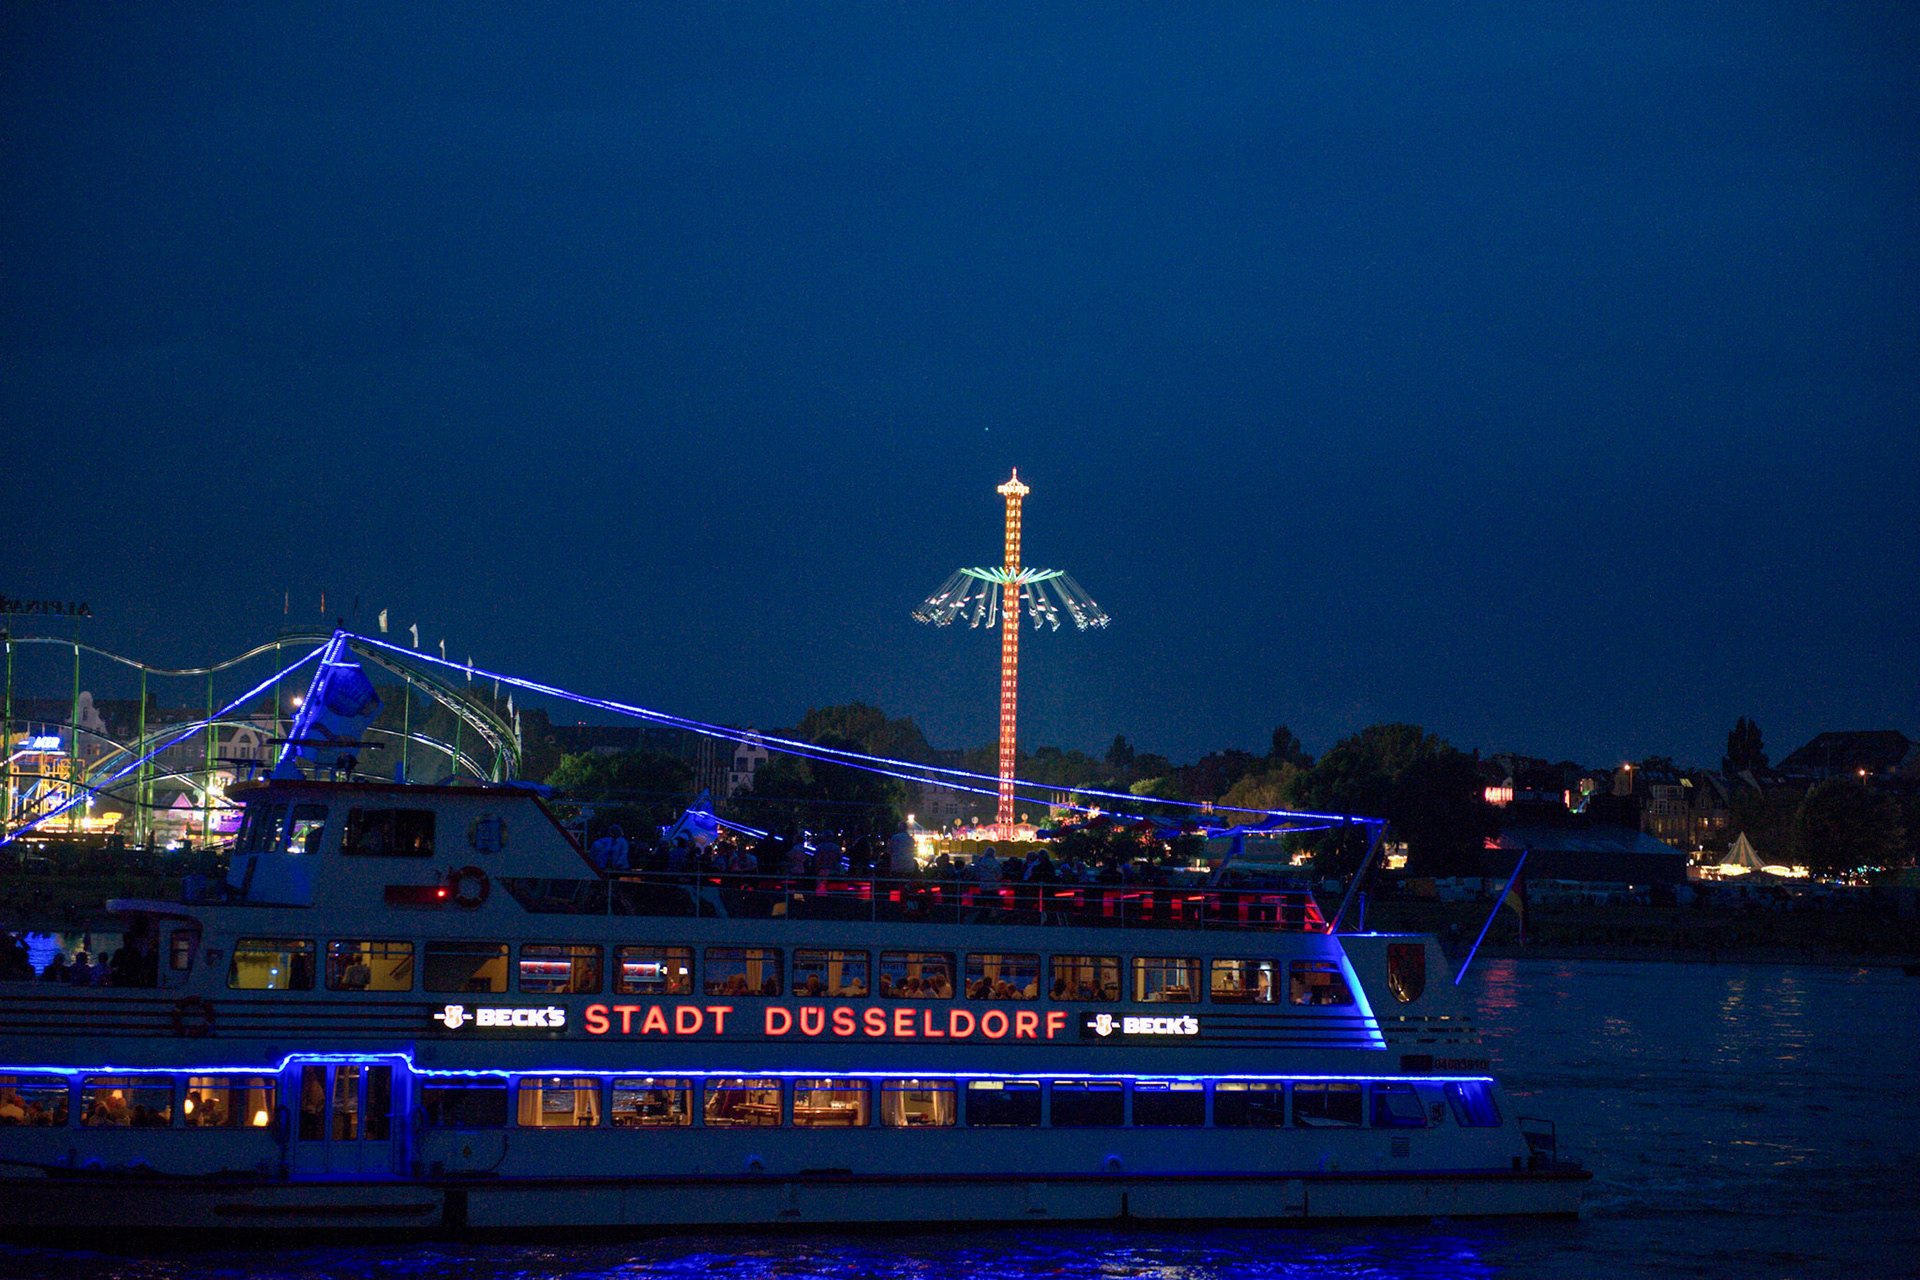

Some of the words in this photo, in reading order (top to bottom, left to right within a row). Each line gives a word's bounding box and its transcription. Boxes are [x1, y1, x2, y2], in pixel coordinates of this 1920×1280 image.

[476, 1006, 566, 1028] BECK'S
[584, 1003, 734, 1036] STADT
[765, 1005, 1068, 1040] DÜSSELDORF
[1123, 1014, 1200, 1036] BECK'S
